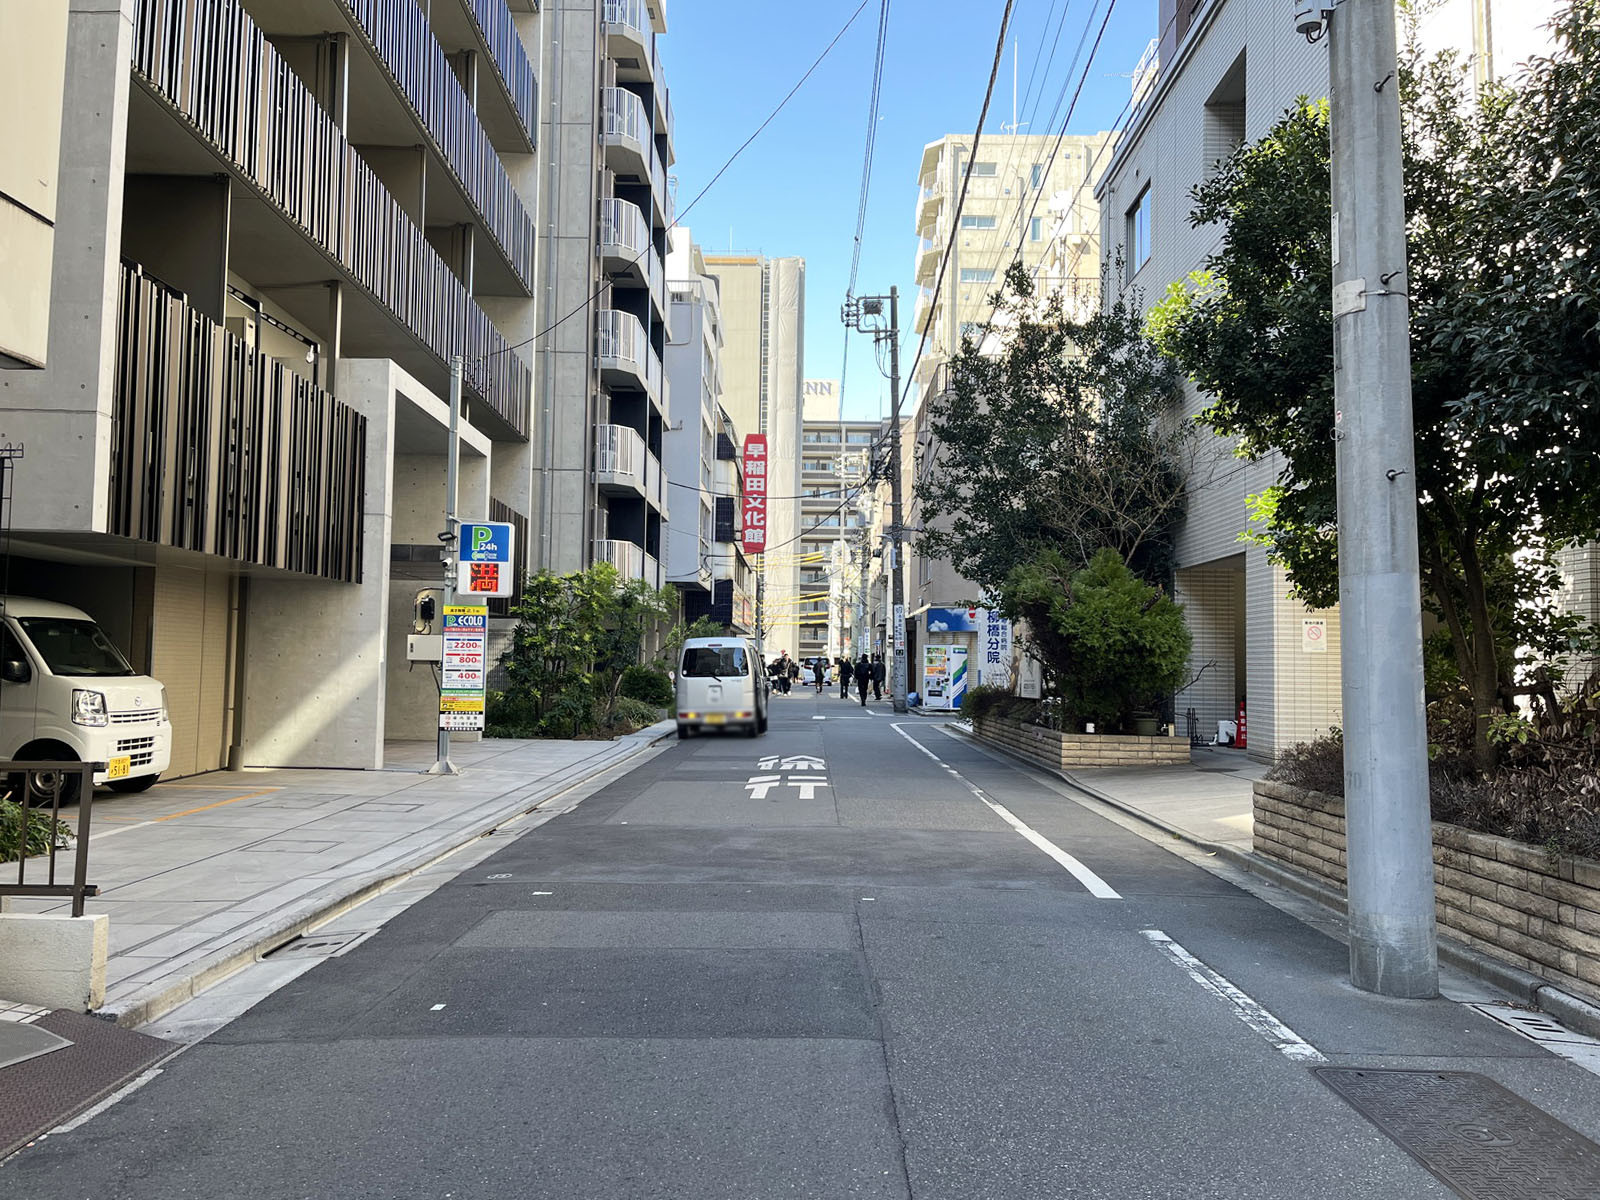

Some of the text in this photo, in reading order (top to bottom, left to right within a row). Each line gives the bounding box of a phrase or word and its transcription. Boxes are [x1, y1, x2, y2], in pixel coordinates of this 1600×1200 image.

[745, 443, 766, 543] 早稲田文化館
[472, 526, 492, 550] P
[470, 563, 499, 592] 満
[458, 615, 483, 626] ECOLO
[987, 610, 1000, 664] 柳橋分院
[744, 754, 828, 800] 徐行
